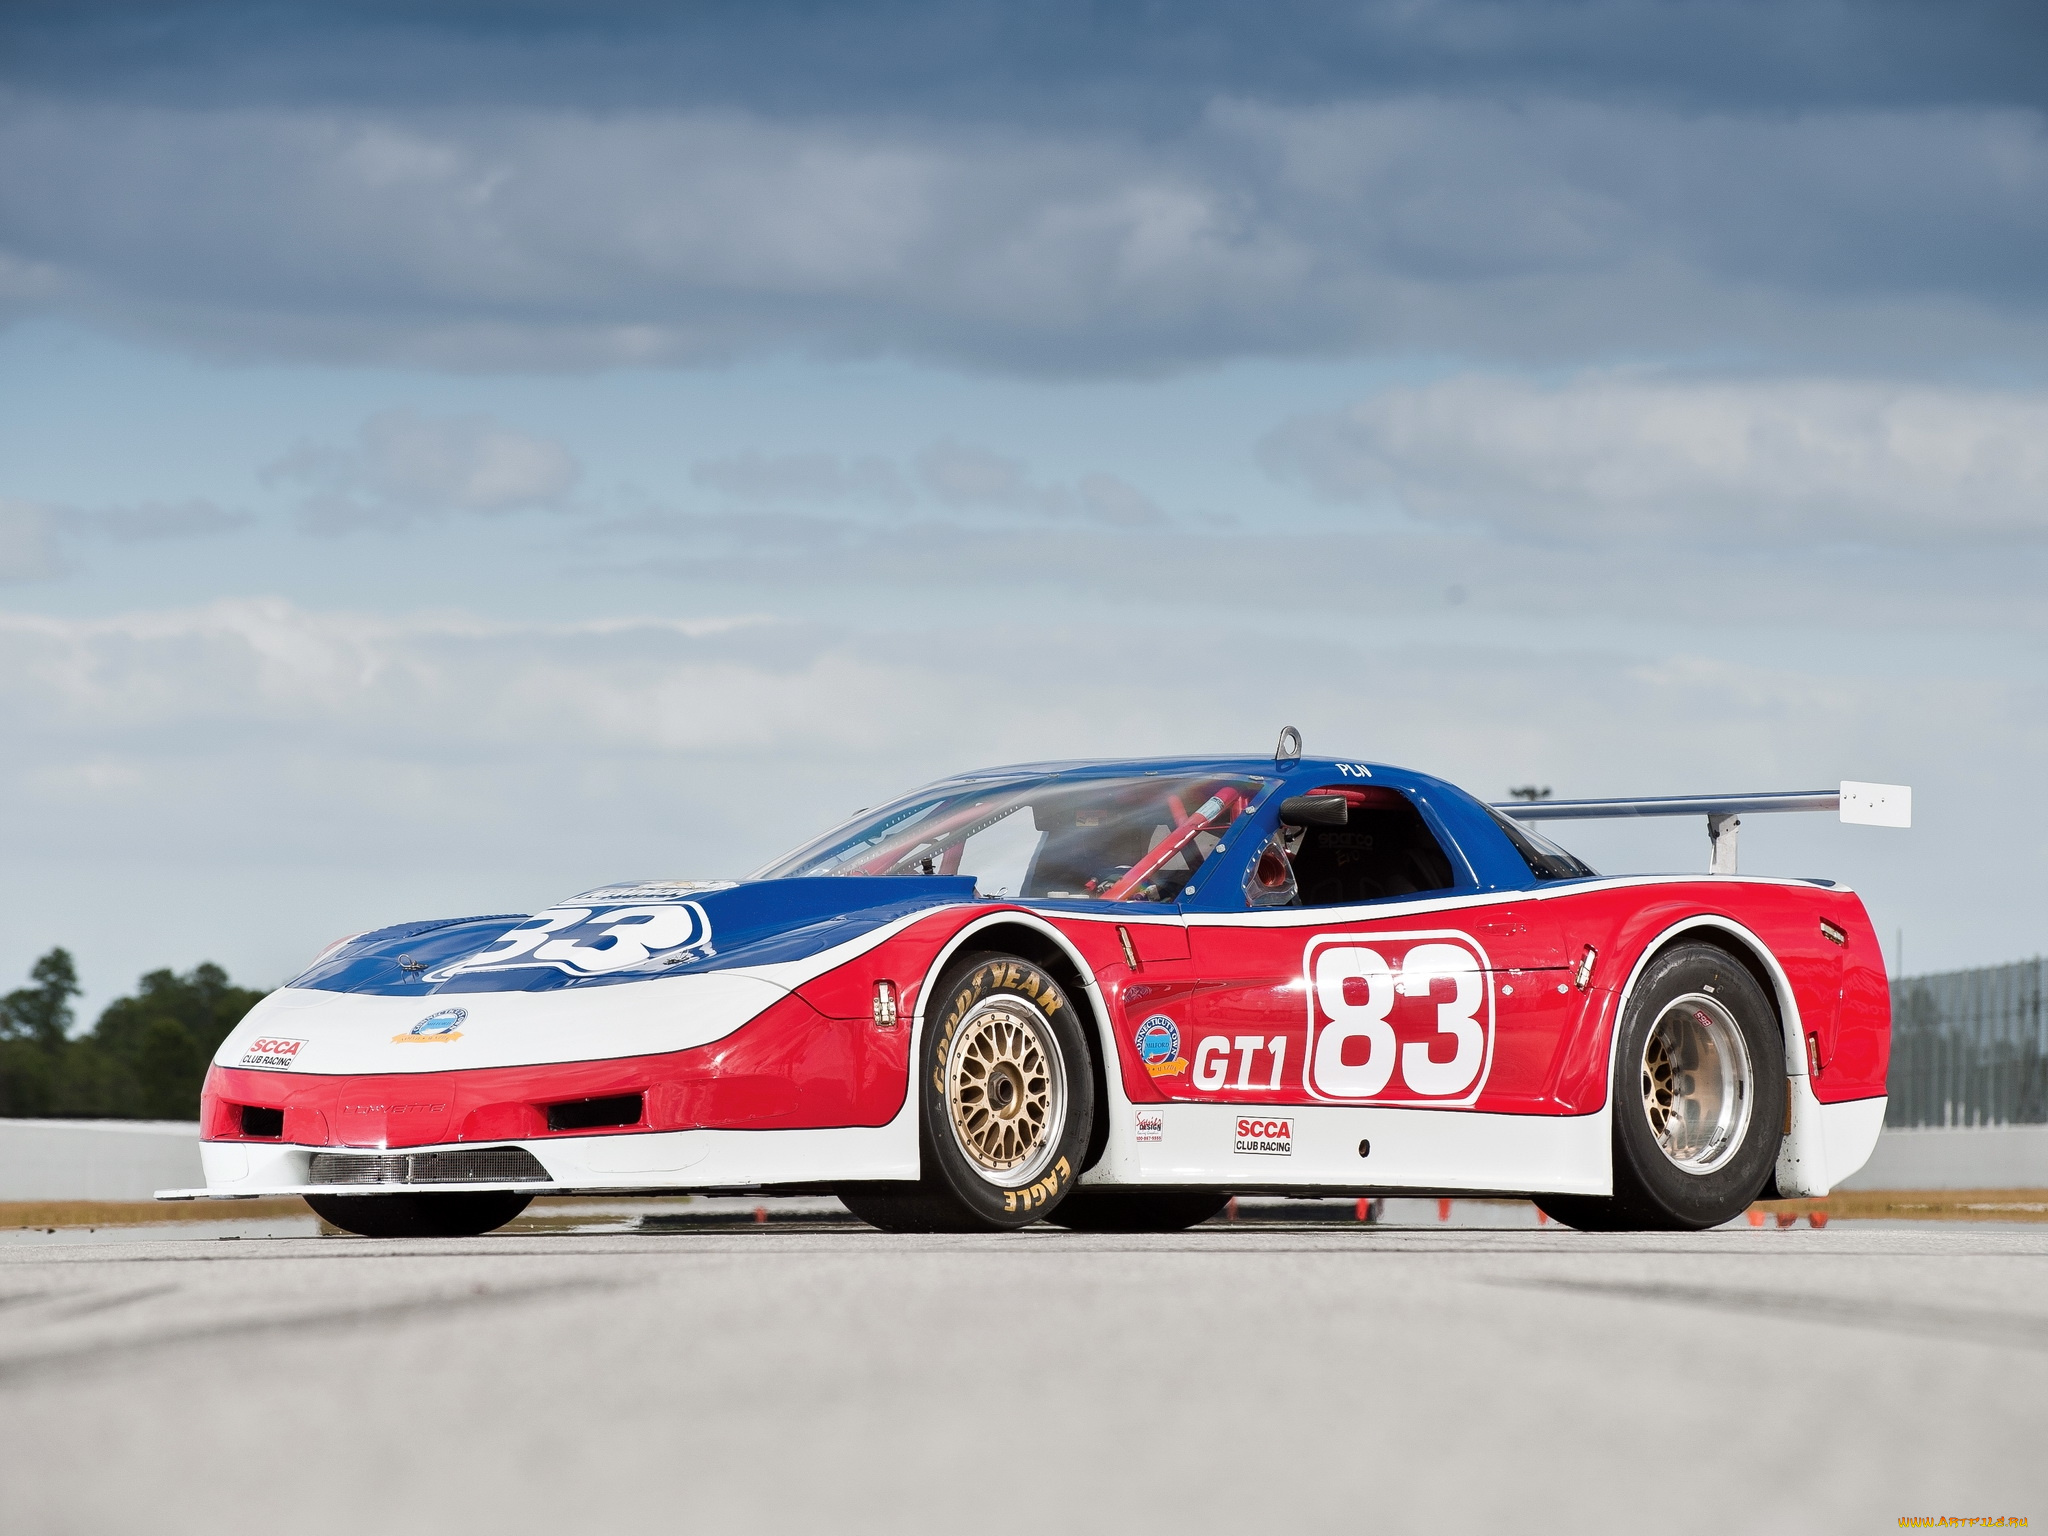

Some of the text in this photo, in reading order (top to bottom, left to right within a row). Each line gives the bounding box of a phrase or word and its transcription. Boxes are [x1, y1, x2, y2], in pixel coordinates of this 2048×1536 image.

[1335, 763, 1372, 777] PLN
[1314, 944, 1484, 1097] 83
[250, 1039, 301, 1055] SCCA
[242, 1055, 292, 1066] CLUB RACING
[1192, 1035, 1287, 1091] GT1
[1237, 1120, 1291, 1138] SCCA
[1236, 1141, 1291, 1152] CLUB RACING
[1004, 1156, 1071, 1212] EAGLE
